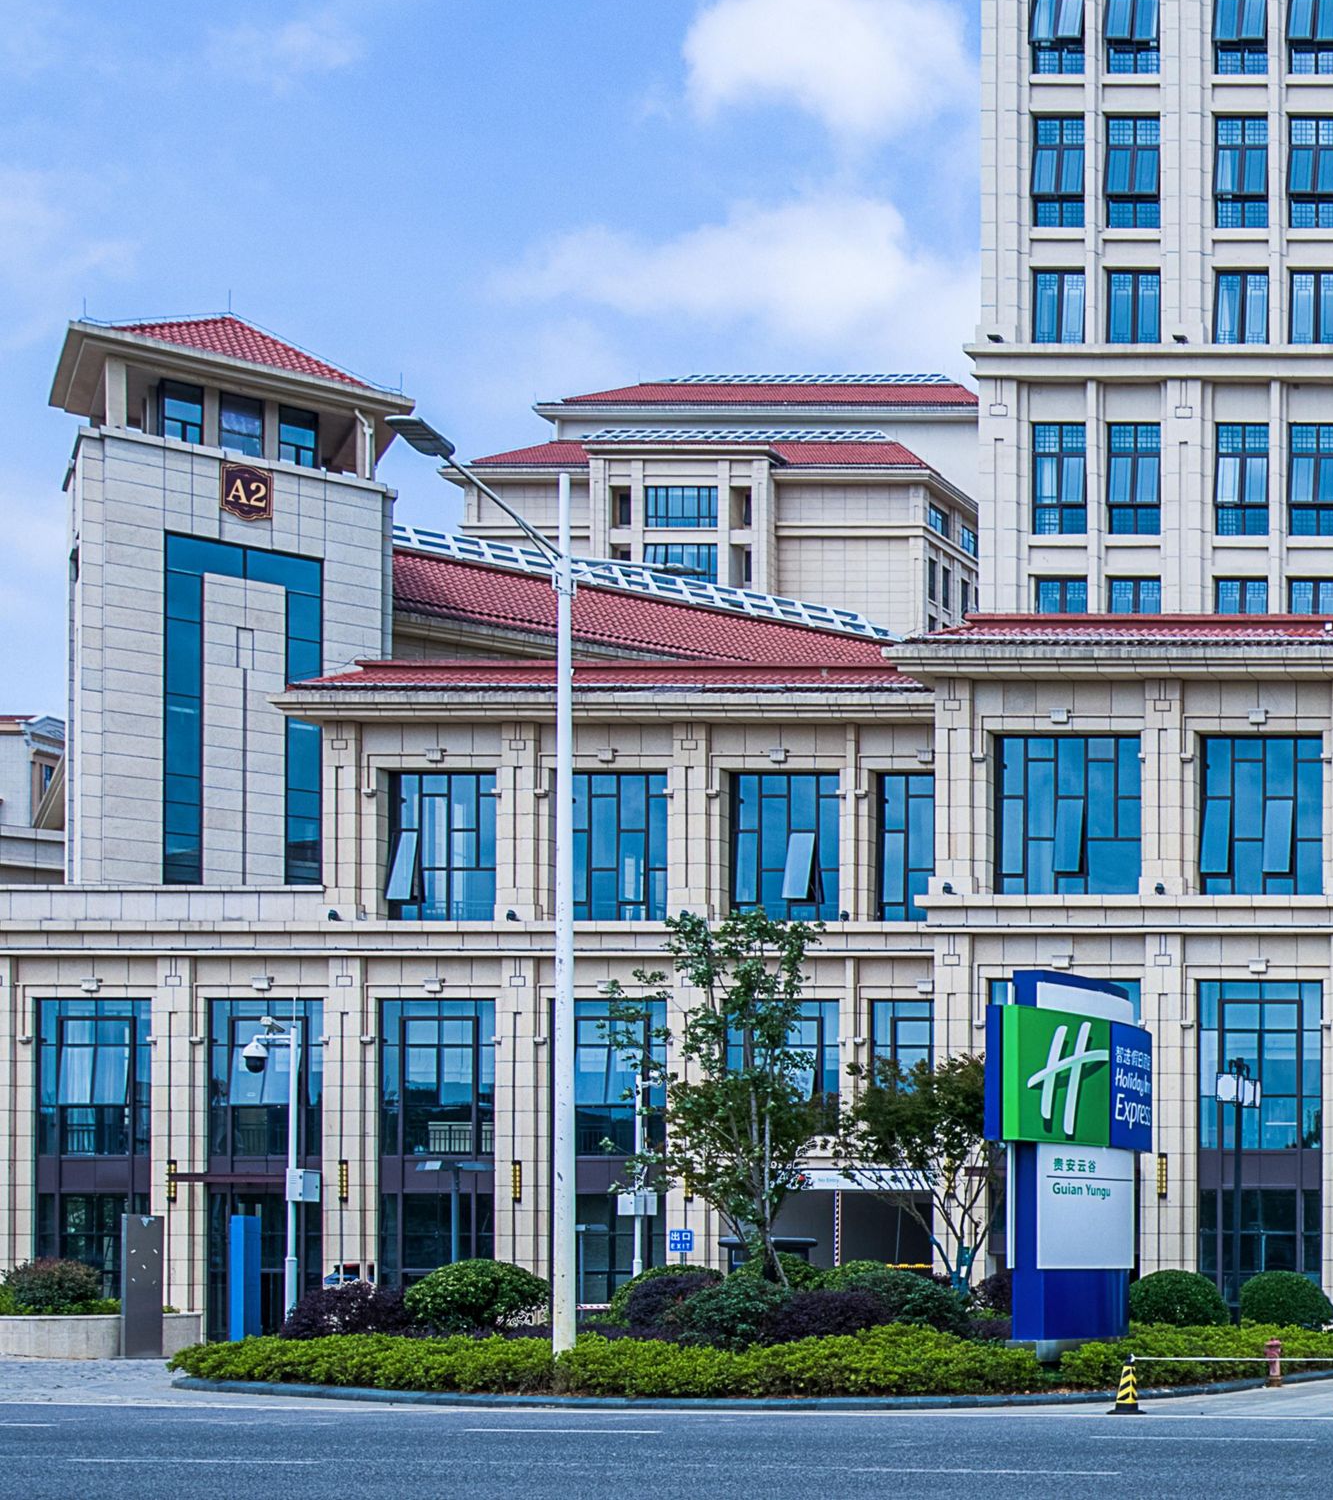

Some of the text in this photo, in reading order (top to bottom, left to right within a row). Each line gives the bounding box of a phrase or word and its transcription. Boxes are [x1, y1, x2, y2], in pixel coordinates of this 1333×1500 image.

[226, 478, 266, 508] A2
[1115, 1067, 1144, 1097] Holiday
[1053, 1157, 1096, 1173] 贵安云谷
[1052, 1182, 1111, 1200] Guian Yungu
[670, 1232, 691, 1241] 出口
